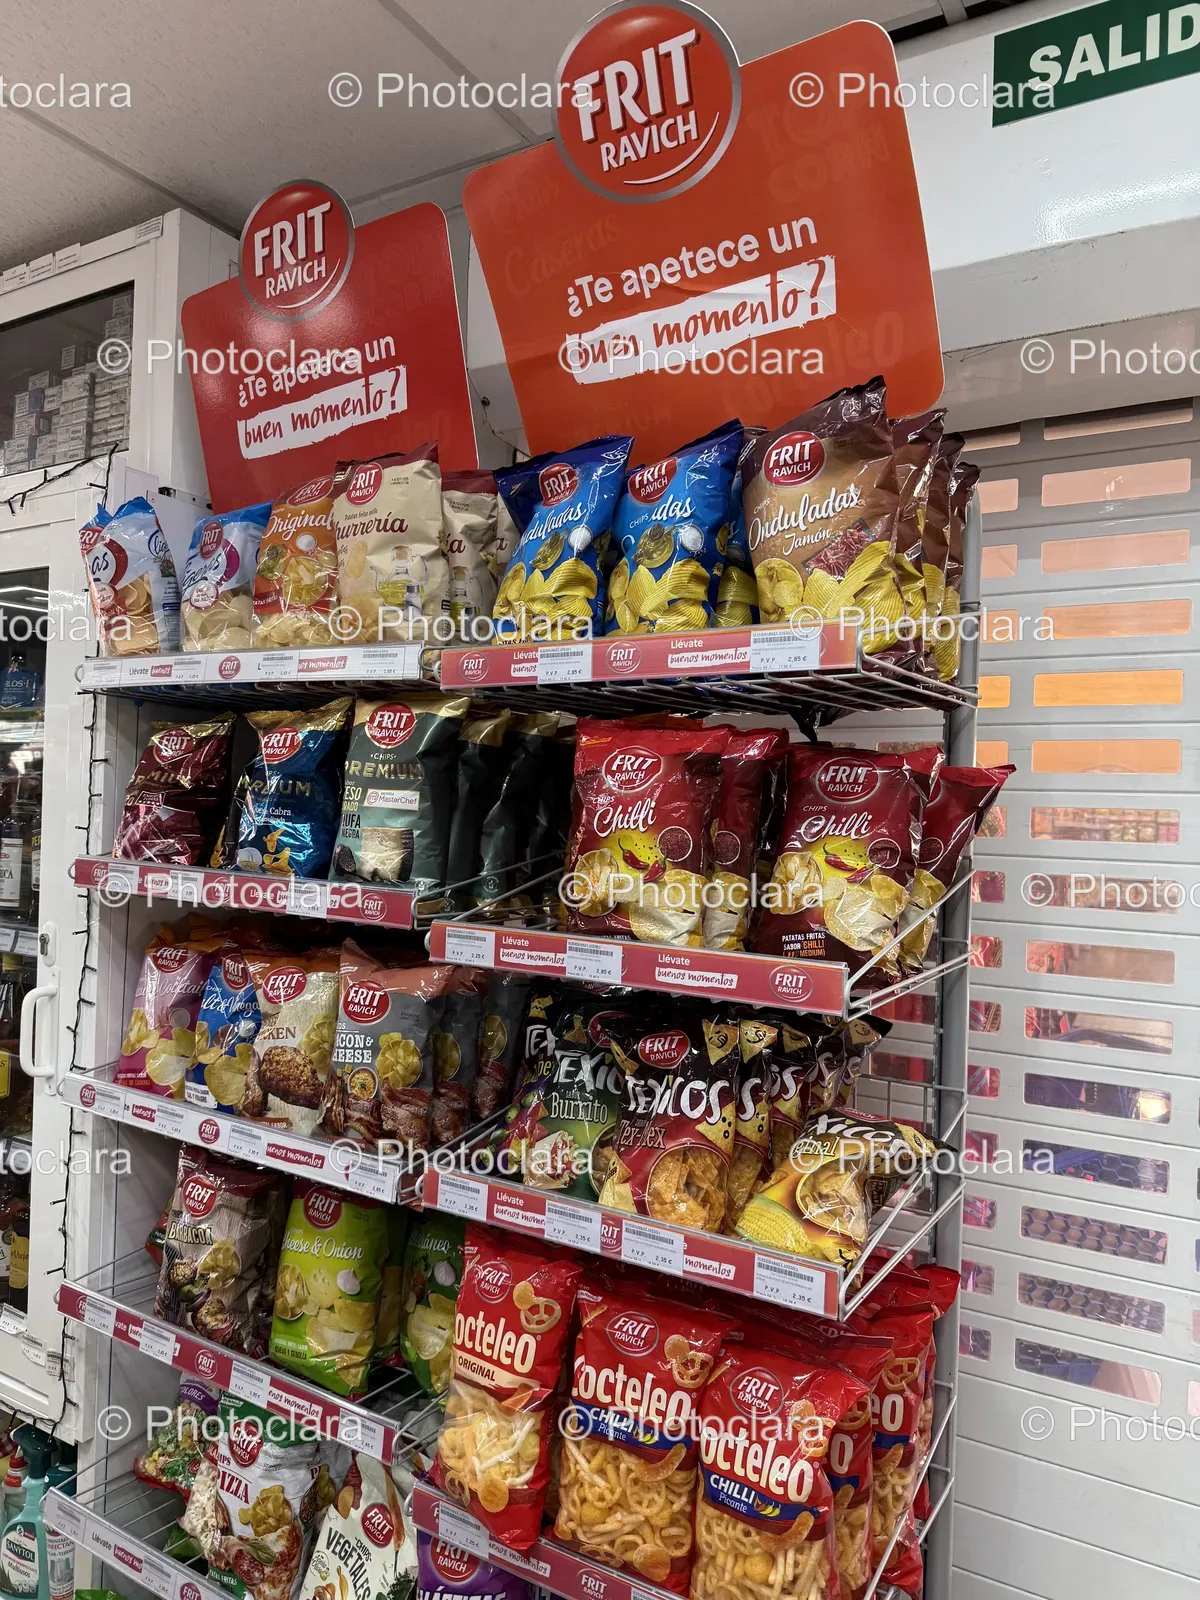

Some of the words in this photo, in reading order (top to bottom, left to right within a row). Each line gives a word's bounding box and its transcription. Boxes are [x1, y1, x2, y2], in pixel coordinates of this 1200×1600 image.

[1028, 2, 1200, 92] SALID
[575, 28, 698, 142] FRIT
[600, 110, 699, 172] RAVICH
[254, 201, 331, 277] FRIT
[567, 275, 614, 317] ¿Te
[620, 233, 759, 293] apetece
[768, 217, 818, 251] un
[265, 260, 327, 299] RAVICH
[577, 332, 640, 370] buen
[651, 258, 827, 348] momento?
[238, 375, 267, 408] ¿Te
[272, 345, 359, 402] apetece
[364, 336, 396, 364] un
[244, 420, 283, 450] buen
[291, 369, 402, 428] momento?
[769, 439, 815, 468] FRIT
[350, 469, 379, 489] FRIT
[635, 460, 670, 489] FRIT
[773, 462, 811, 478] RAVICH
[297, 480, 328, 497] FRIT
[351, 485, 374, 498] RAVICH
[543, 472, 571, 498] FRIT
[640, 478, 668, 497] RAVICH
[754, 499, 770, 513] CHIPS
[262, 511, 334, 541] Original
[335, 512, 408, 541] hurrería
[629, 515, 649, 529] CHIPS
[748, 485, 861, 551] Onduladas
[202, 528, 222, 544] FRIT
[783, 528, 831, 556] Jamón
[670, 639, 704, 649] Llévate
[308, 656, 345, 670] momentos
[610, 648, 636, 661] FRIT
[612, 659, 632, 667] RAVICH
[670, 653, 699, 664] buenos
[701, 648, 748, 662] momentos
[129, 667, 149, 676] Llévate
[221, 661, 239, 670] FRIT
[463, 658, 485, 670] FRIT
[513, 664, 537, 673] buenos
[373, 711, 411, 729] FRIT
[375, 728, 403, 738] RAVICH
[611, 754, 658, 771] FRIT
[614, 770, 646, 781] RAVICH
[824, 765, 872, 784] FRIT
[827, 783, 863, 794] RAVICH
[379, 796, 418, 805] MasterChef
[592, 795, 616, 804] CHIPS
[269, 807, 292, 816] Cabra
[593, 798, 658, 838] Chilli
[803, 805, 828, 813] CHIPS
[341, 828, 360, 839] NEGRA
[800, 811, 873, 843] Chilli
[364, 900, 383, 911] FRIT
[502, 936, 530, 947] Llévate
[782, 933, 805, 942] PATATAS
[806, 932, 825, 941] FRITAS
[783, 942, 801, 951] SABOR
[803, 940, 825, 949] CHILLI
[156, 947, 184, 961] FRIT
[157, 958, 179, 968] RAVICH
[501, 950, 526, 960] buenos
[527, 952, 565, 965] momentos
[658, 953, 691, 966] Llévate
[224, 958, 244, 976] FRIT
[574, 964, 588, 972] P.V.P.
[657, 966, 687, 982] buenos
[688, 972, 734, 986] momentos
[160, 977, 205, 996] Cocktail
[267, 973, 301, 990] FRIT
[774, 972, 807, 988] FRIT
[347, 987, 385, 1007] FRIT
[777, 984, 802, 995] RAVICH
[348, 1004, 377, 1016] RAVICH
[645, 1034, 684, 1053] FRIT
[650, 1049, 678, 1061] RAVICH
[81, 1087, 96, 1100] FRIT
[550, 1092, 609, 1125] Burrito
[200, 1124, 218, 1136] FRIT
[286, 1151, 322, 1168] momentos
[184, 1181, 216, 1204] FRIT
[496, 1192, 525, 1206] Llévate
[185, 1197, 205, 1211] RAVICH
[308, 1192, 340, 1215] FRIT
[464, 1203, 474, 1212] 2,35
[495, 1206, 520, 1219] buenos
[308, 1207, 332, 1223] RAVICH
[168, 1220, 214, 1246] BARBACOA
[552, 1227, 567, 1237] P.V.P.
[575, 1233, 586, 1242] 2,35
[600, 1223, 621, 1238] RIT
[310, 1235, 321, 1258] &
[323, 1241, 364, 1260] Onion
[631, 1248, 646, 1258] P.V.P.
[655, 1254, 668, 1264] 2,35
[685, 1256, 732, 1278] momentos
[481, 1267, 510, 1288] FRIT
[480, 1280, 501, 1295] RAVICH
[764, 1284, 781, 1296] P.V.P.
[792, 1292, 806, 1302] 2,35
[613, 1316, 657, 1340] FRIT
[453, 1311, 538, 1374] octeleo
[614, 1330, 645, 1348] RAVICH
[197, 1355, 215, 1369] FRIT
[458, 1355, 497, 1382] ORIGINAL
[736, 1375, 780, 1401] FRIT
[284, 1395, 320, 1417] momentos
[737, 1390, 769, 1411] RAVICH
[590, 1408, 633, 1432] CHILLI
[597, 1421, 627, 1442] Picante
[700, 1427, 816, 1502] octeleo
[709, 1473, 754, 1504] CHILLI
[718, 1491, 749, 1514] Picante
[366, 1507, 394, 1535] FRIT
[364, 1520, 384, 1541] RAVICH
[92, 1532, 112, 1551] Llévate
[465, 1537, 475, 1547] 2,25
[6, 1541, 35, 1562] SANYTOL
[7, 1561, 31, 1579] Multiusos
[326, 1527, 372, 1600] VEGETALES
[437, 1555, 468, 1574] RAVICH
[508, 1551, 548, 1576] momentos
[581, 1575, 608, 1594] FRIT
